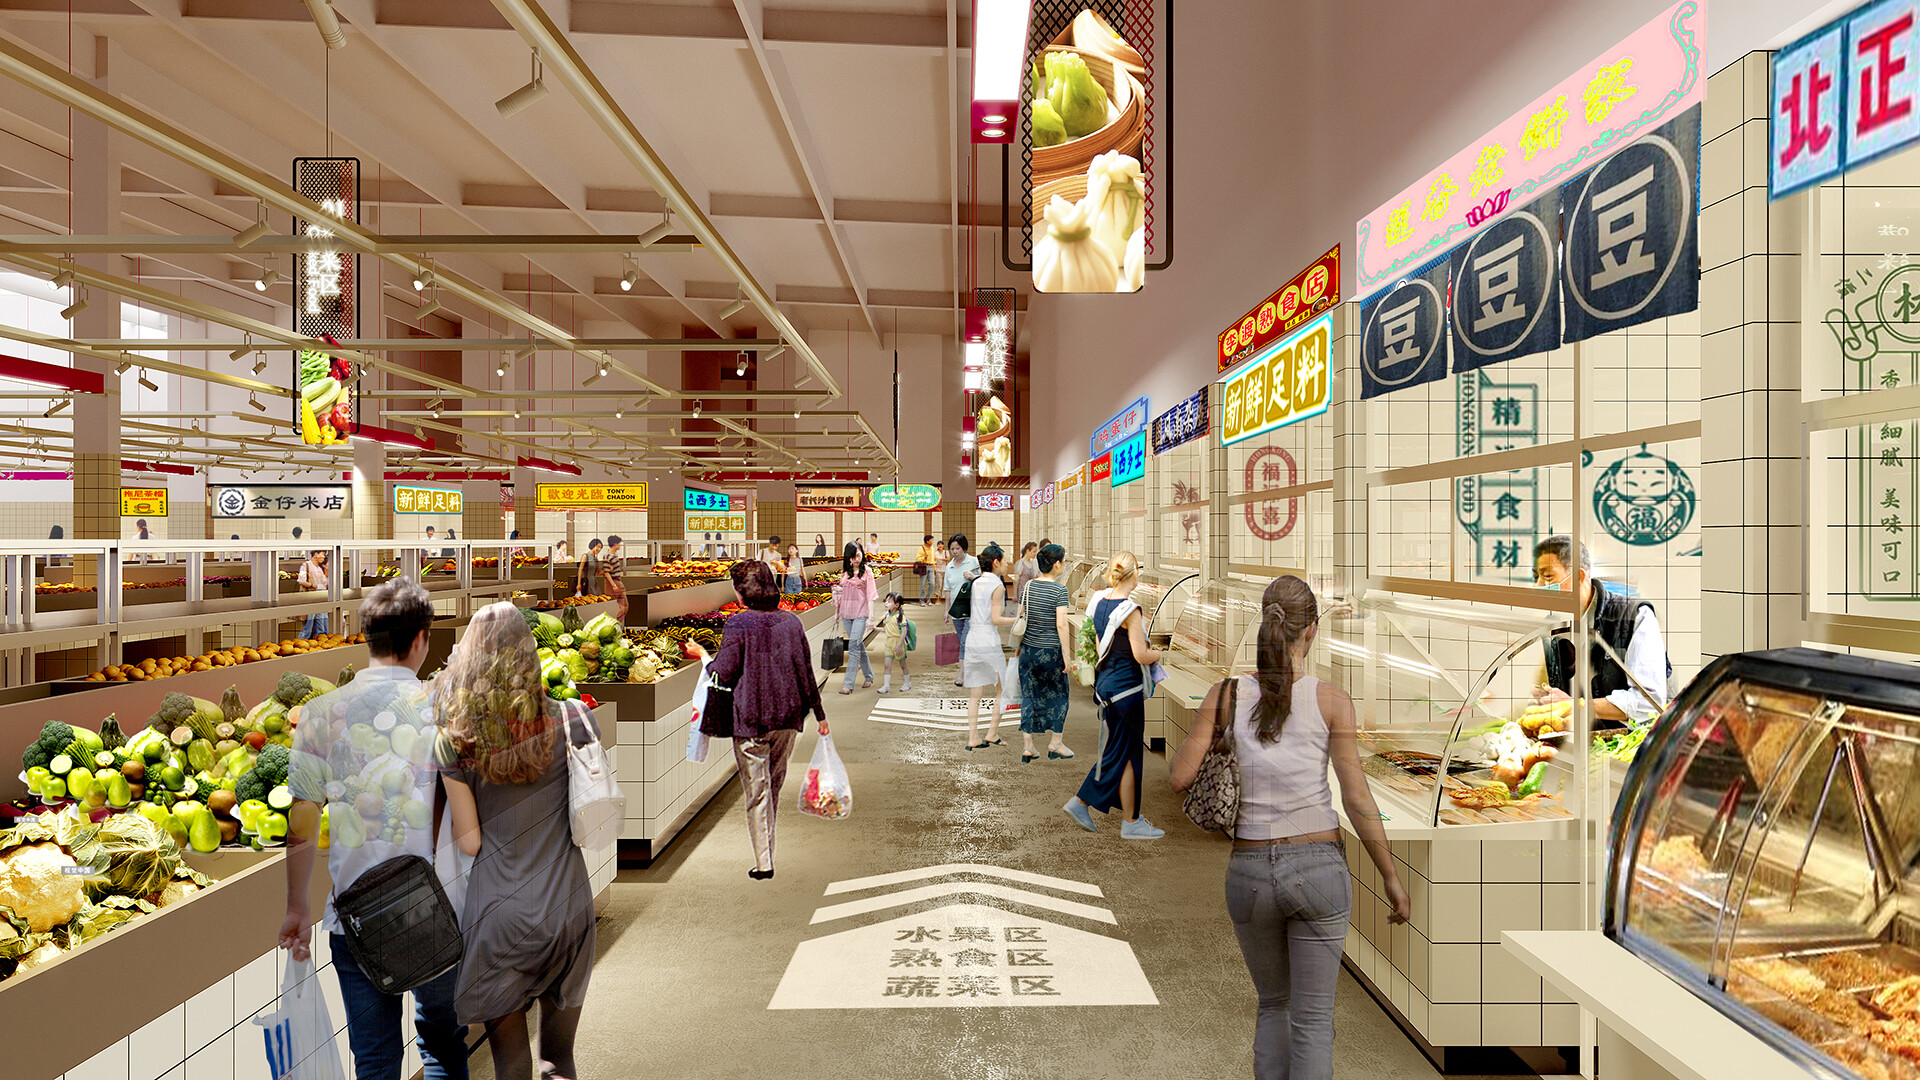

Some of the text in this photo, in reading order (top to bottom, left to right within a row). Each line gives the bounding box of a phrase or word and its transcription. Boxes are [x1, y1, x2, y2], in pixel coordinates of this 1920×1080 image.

[1591, 164, 1656, 291] 豆
[1473, 234, 1526, 333] 豆
[1225, 268, 1325, 352] 李渡熟食店
[1378, 296, 1421, 369] 豆
[1225, 335, 1325, 432] 新鮮足料
[1880, 369, 1904, 467] 香細膩
[1462, 374, 1475, 513] HONGKON OOD
[250, 495, 345, 511] 金仔米店
[398, 490, 461, 511] 新鮮足料
[547, 488, 604, 500] 歡迎光臨
[696, 494, 727, 508] 西多士
[1492, 397, 1521, 568] 精食材
[1631, 506, 1657, 531] 福
[888, 948, 1054, 967] 熟食区
[894, 926, 1047, 943] 水果区
[882, 975, 1061, 998] 蔬菜区
